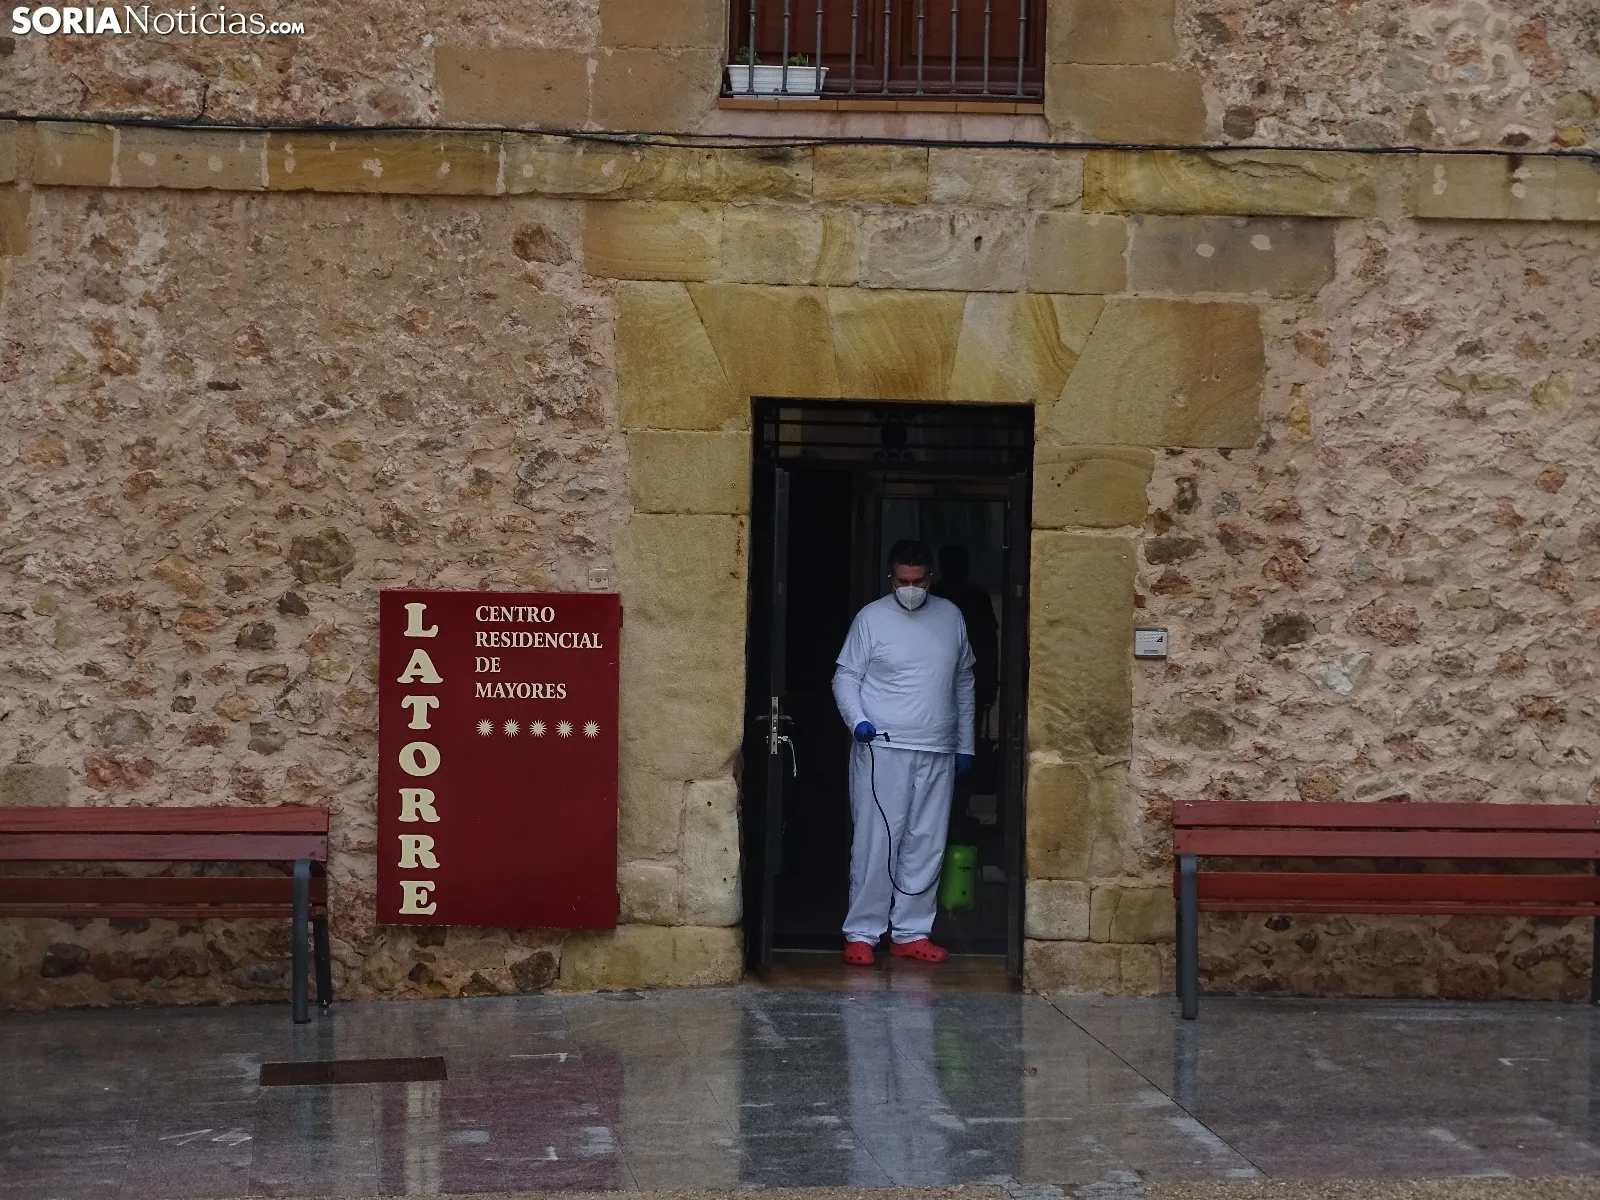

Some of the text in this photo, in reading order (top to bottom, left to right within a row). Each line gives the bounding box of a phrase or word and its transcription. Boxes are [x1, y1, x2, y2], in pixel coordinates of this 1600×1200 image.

[475, 605, 556, 623] CENTRO
[475, 631, 604, 649] RESIDENCIAL
[475, 656, 502, 673] DE
[475, 682, 567, 700] MAYORES
[396, 602, 444, 916] LATORRE
